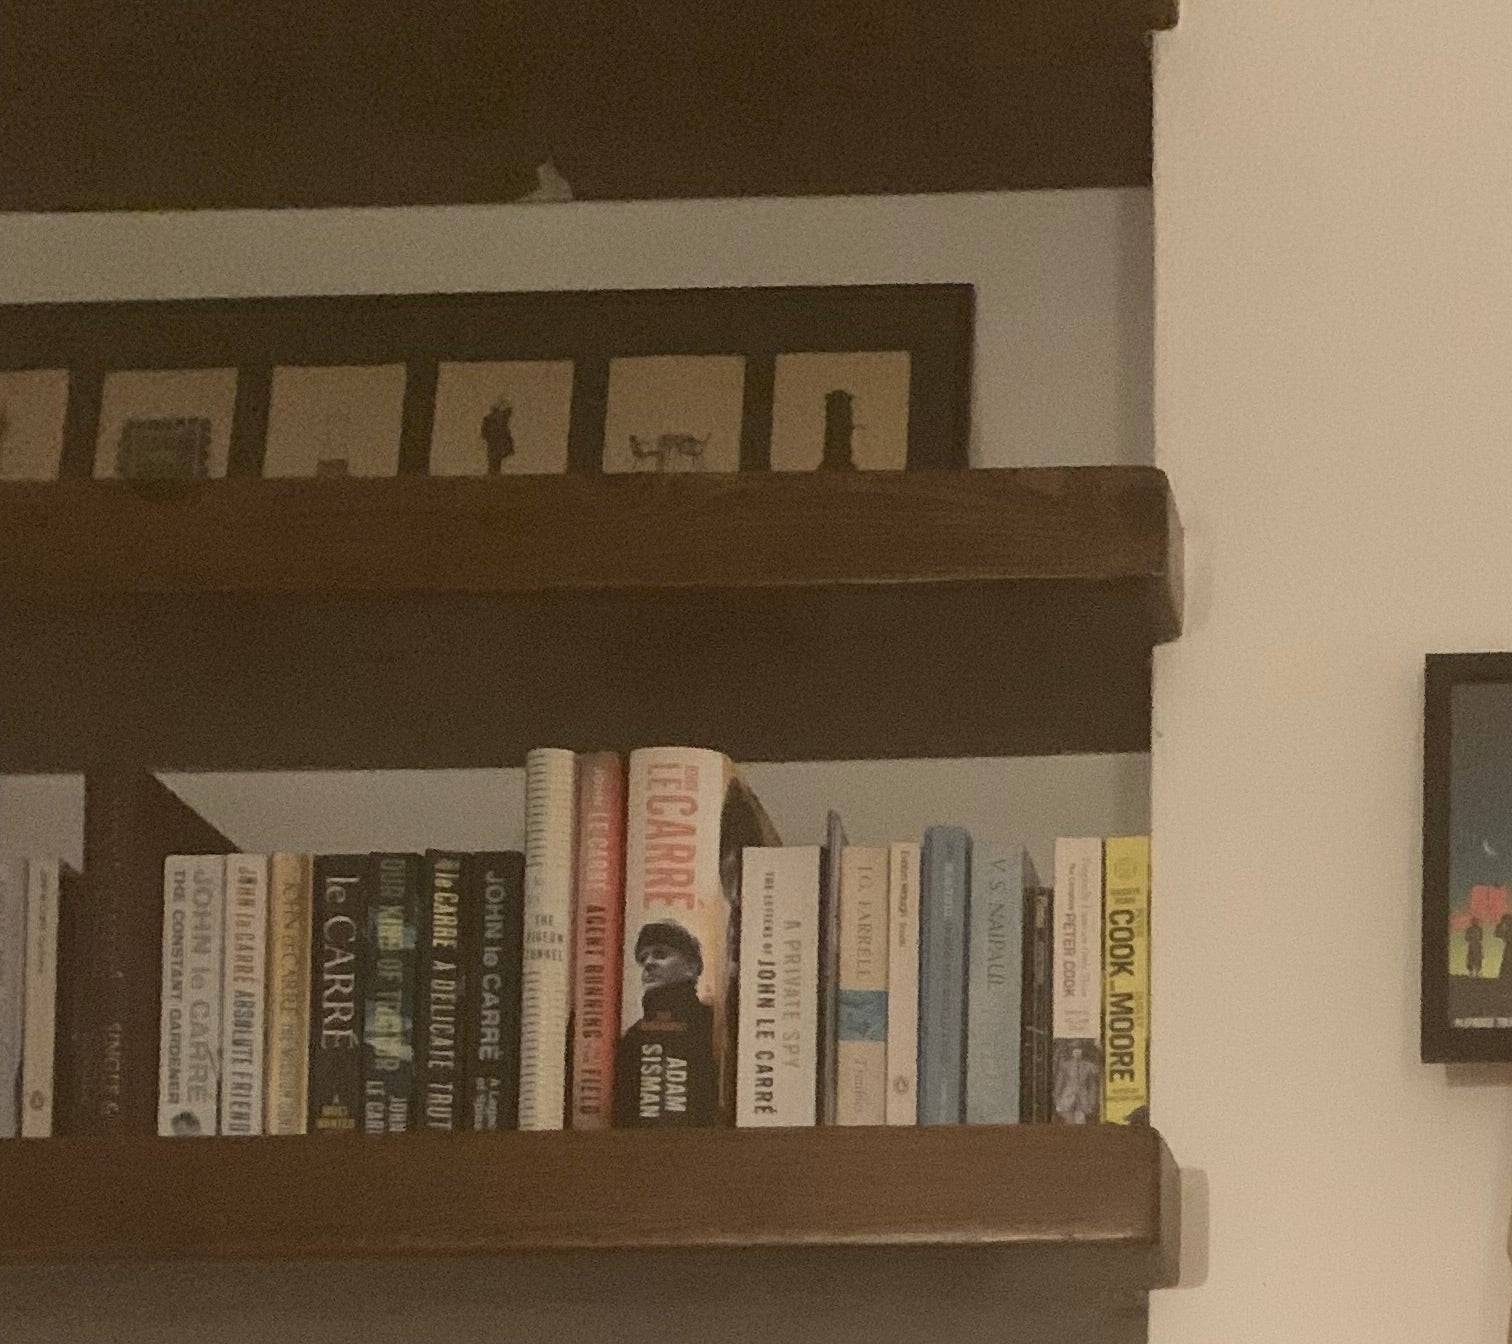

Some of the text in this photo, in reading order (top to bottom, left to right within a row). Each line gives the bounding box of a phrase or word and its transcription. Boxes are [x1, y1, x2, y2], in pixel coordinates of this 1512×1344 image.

[643, 763, 704, 910] LE CARRÉ
[193, 869, 215, 955] JOHN
[237, 866, 259, 907] JOHN
[379, 858, 406, 898] OUR
[321, 876, 360, 1050] le CARRÉ
[477, 870, 506, 1061] JOHN le CARRÉ
[584, 905, 606, 957] AGENT
[986, 903, 1006, 990] NAIPAUL
[1062, 913, 1076, 956] PETER
[166, 870, 187, 1104] THE CONSTANT GARDENER
[191, 967, 211, 989] le
[582, 964, 606, 1039] RUNNING
[755, 959, 777, 1010] JOHN
[780, 920, 802, 1069] A PRIVATE SPY
[1061, 960, 1076, 998] COOK
[231, 990, 256, 1065] ABSOLUTE
[427, 978, 457, 1069] DELICATE
[755, 1019, 776, 1041] LE
[638, 1043, 663, 1118] SISMAN
[664, 1057, 688, 1112] ADAM
[752, 1051, 779, 1116] CARRÉ
